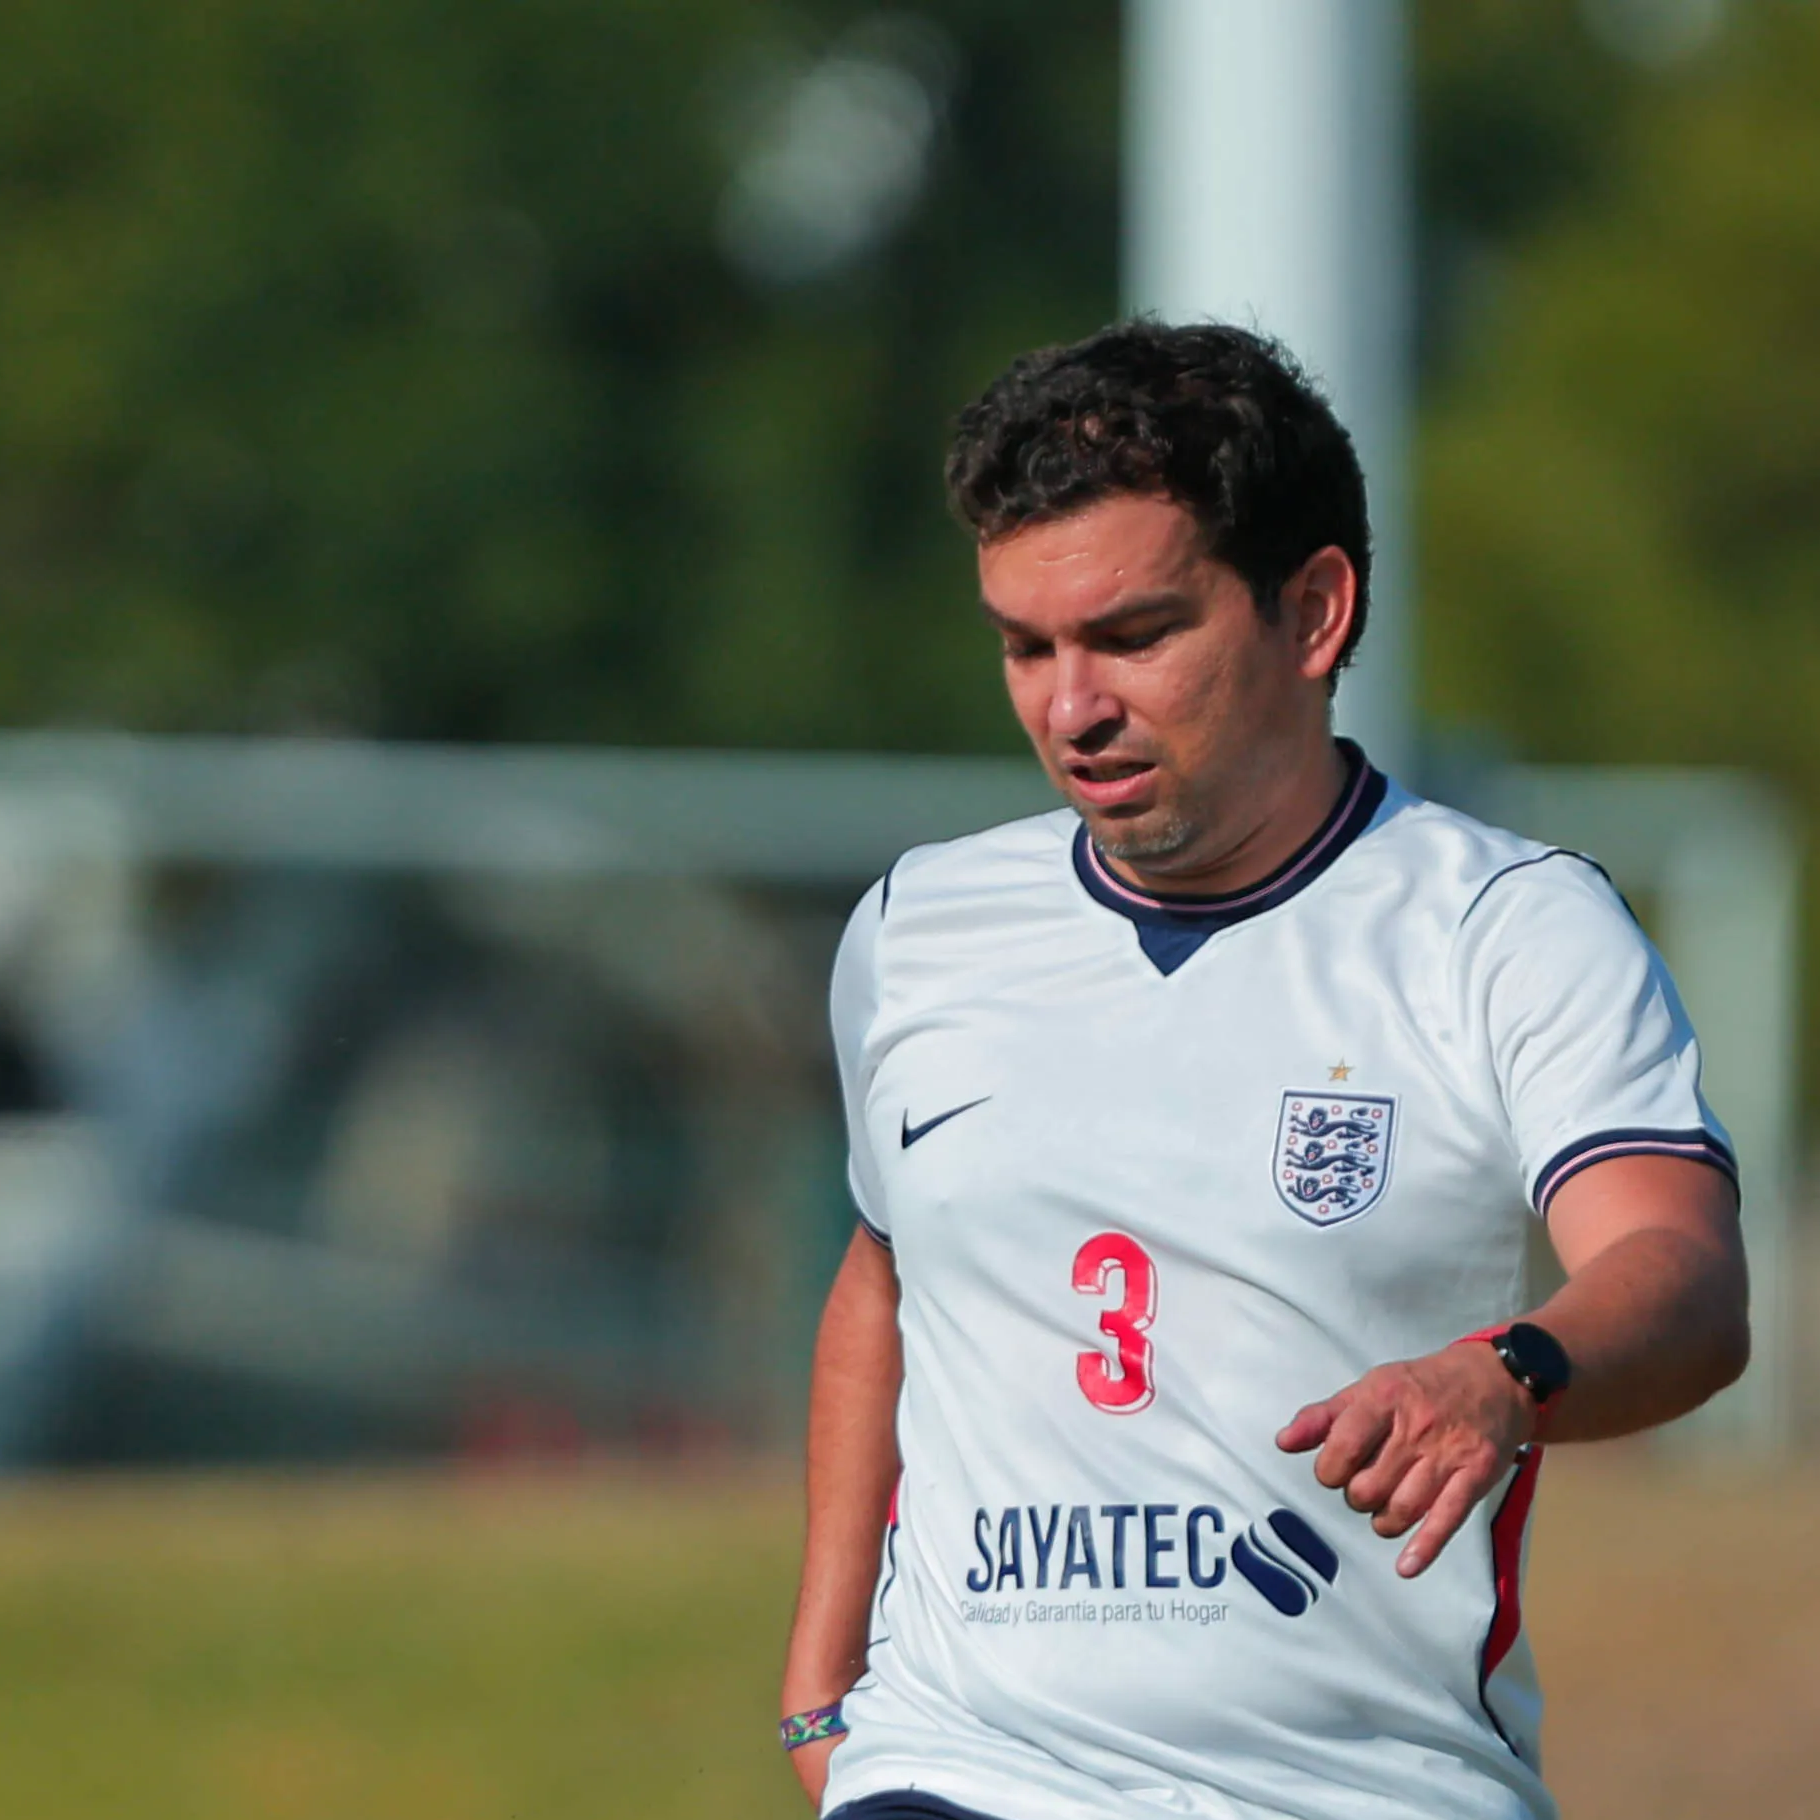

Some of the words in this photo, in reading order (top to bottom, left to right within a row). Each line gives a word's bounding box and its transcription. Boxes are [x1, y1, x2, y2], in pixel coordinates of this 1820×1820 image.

[1071, 1230, 1159, 1416] 3
[966, 1503, 1227, 1593] SAYATEC
[961, 1599, 1011, 1624] Calidad
[1013, 1603, 1023, 1629] y
[1101, 1603, 1142, 1627] para
[1146, 1599, 1166, 1621] tu
[1170, 1598, 1230, 1626] Hogar
